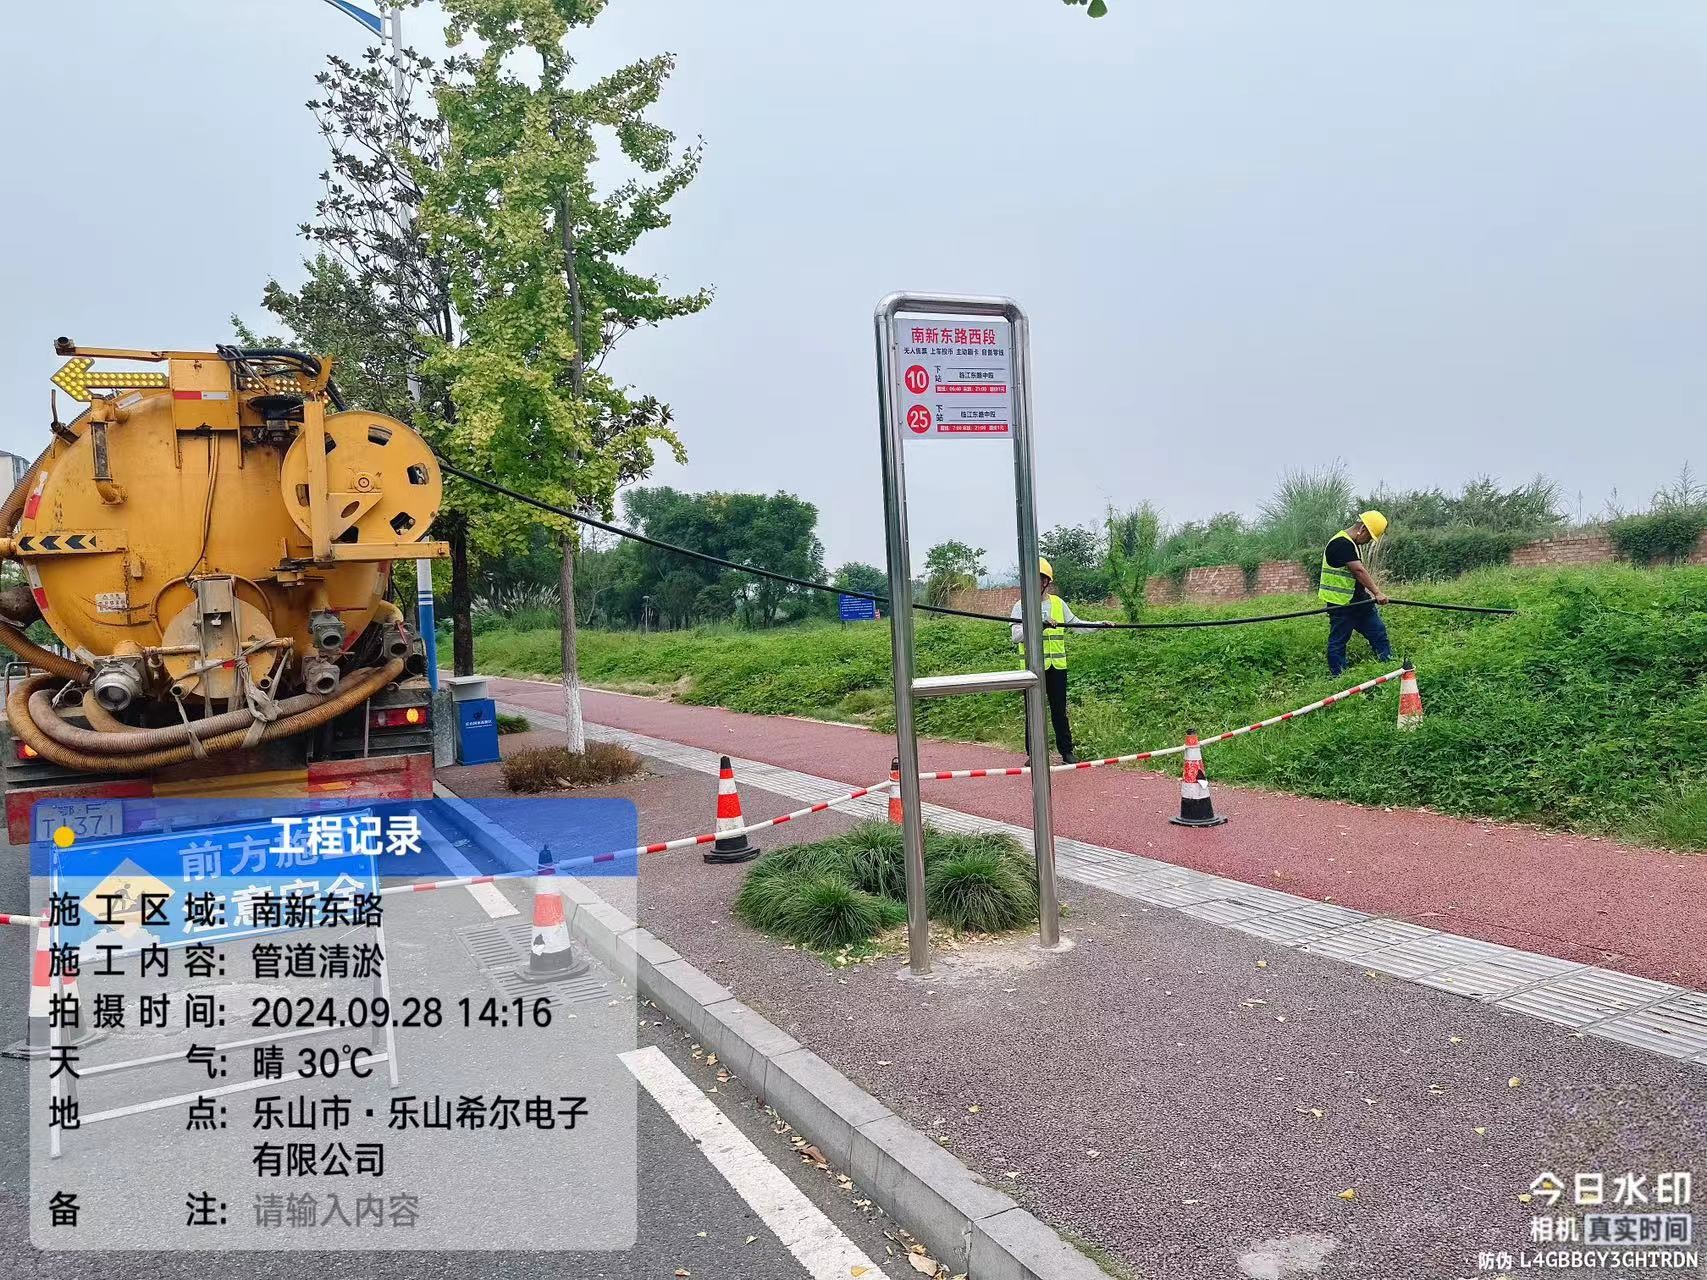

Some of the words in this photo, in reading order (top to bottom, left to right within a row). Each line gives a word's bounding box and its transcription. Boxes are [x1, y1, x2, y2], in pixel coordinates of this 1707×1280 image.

[911, 327, 996, 345] 南新东路西段
[907, 371, 926, 389] 10
[910, 411, 928, 428] 25
[179, 824, 362, 882] 前方施
